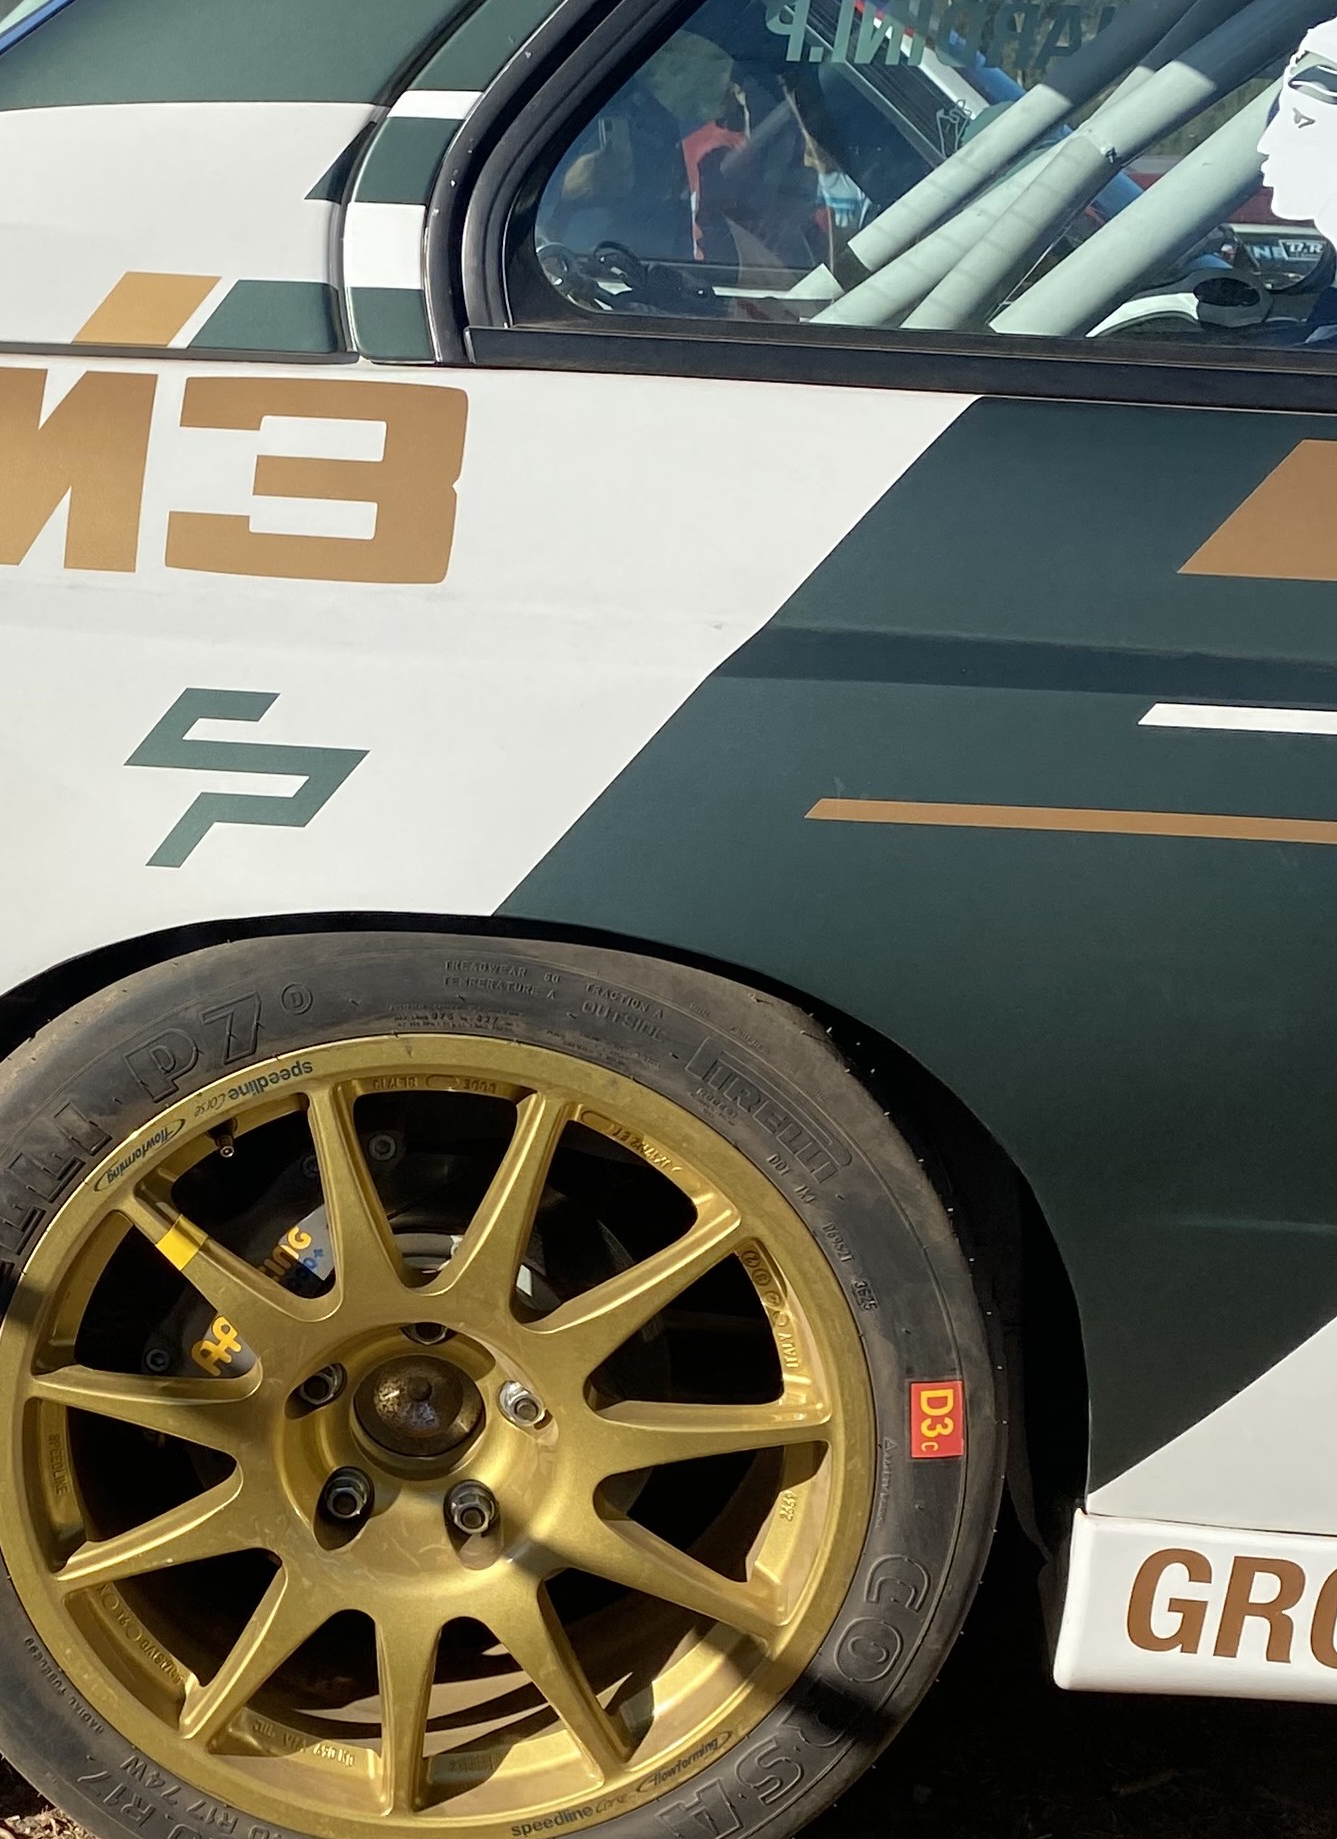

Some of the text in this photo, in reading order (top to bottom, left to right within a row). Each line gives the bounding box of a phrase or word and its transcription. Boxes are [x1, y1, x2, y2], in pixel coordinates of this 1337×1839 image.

[443, 976, 538, 996] TEMPERATURE
[444, 960, 527, 978] TREADWEAR
[585, 982, 649, 1013] TRACTION
[581, 1001, 663, 1042] OUTSIDE
[123, 990, 262, 1103] P7
[228, 1060, 313, 1101] speedline
[685, 1035, 852, 1184] PIRELLI
[106, 1124, 178, 1184] flowforming
[48, 1433, 70, 1498] SPEEDLINE
[653, 1738, 719, 1787] flowforming
[76, 1768, 157, 1828] R17
[183, 1797, 240, 1833] R17
[511, 1804, 594, 1839] speedline
